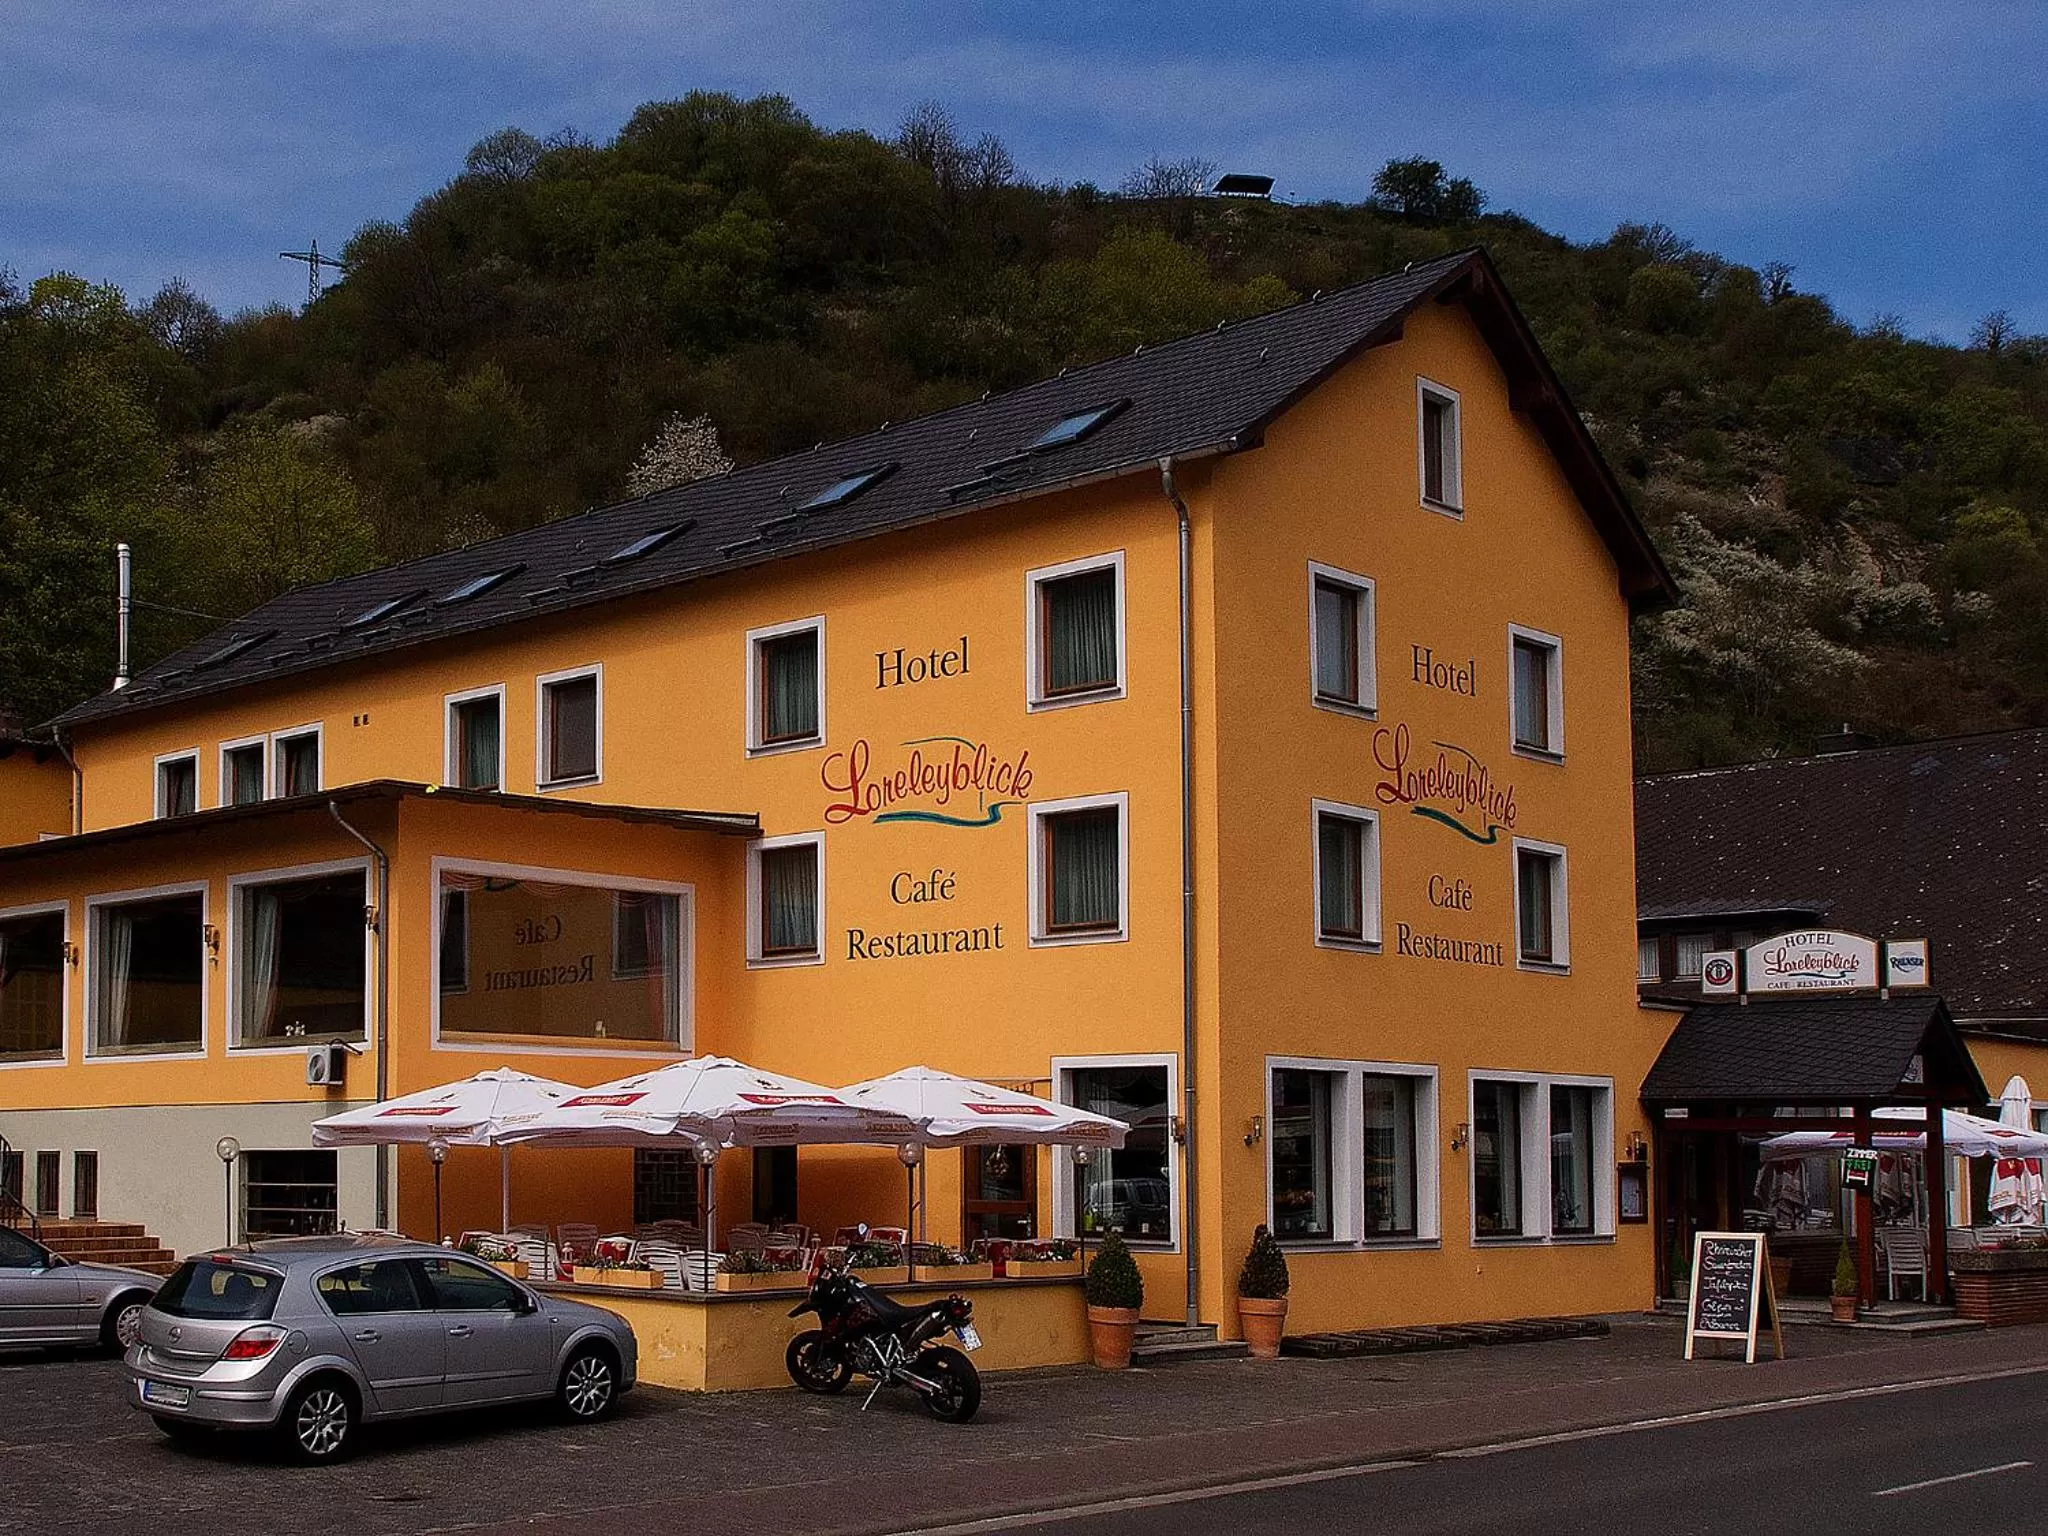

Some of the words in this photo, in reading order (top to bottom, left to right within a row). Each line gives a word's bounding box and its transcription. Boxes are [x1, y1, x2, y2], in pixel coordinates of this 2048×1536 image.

[875, 635, 970, 690] Hotel
[1411, 644, 1477, 697] Hotel
[821, 739, 1034, 825] Loreleyblick
[1372, 722, 1517, 829] Loreleyblick
[891, 868, 956, 905] Café
[1427, 874, 1474, 912] Café
[846, 922, 1005, 961] Restaurant
[1396, 921, 1504, 968] Restaurant
[1763, 948, 1860, 977] Loreleyblick
[1784, 933, 1835, 949] HOTEL
